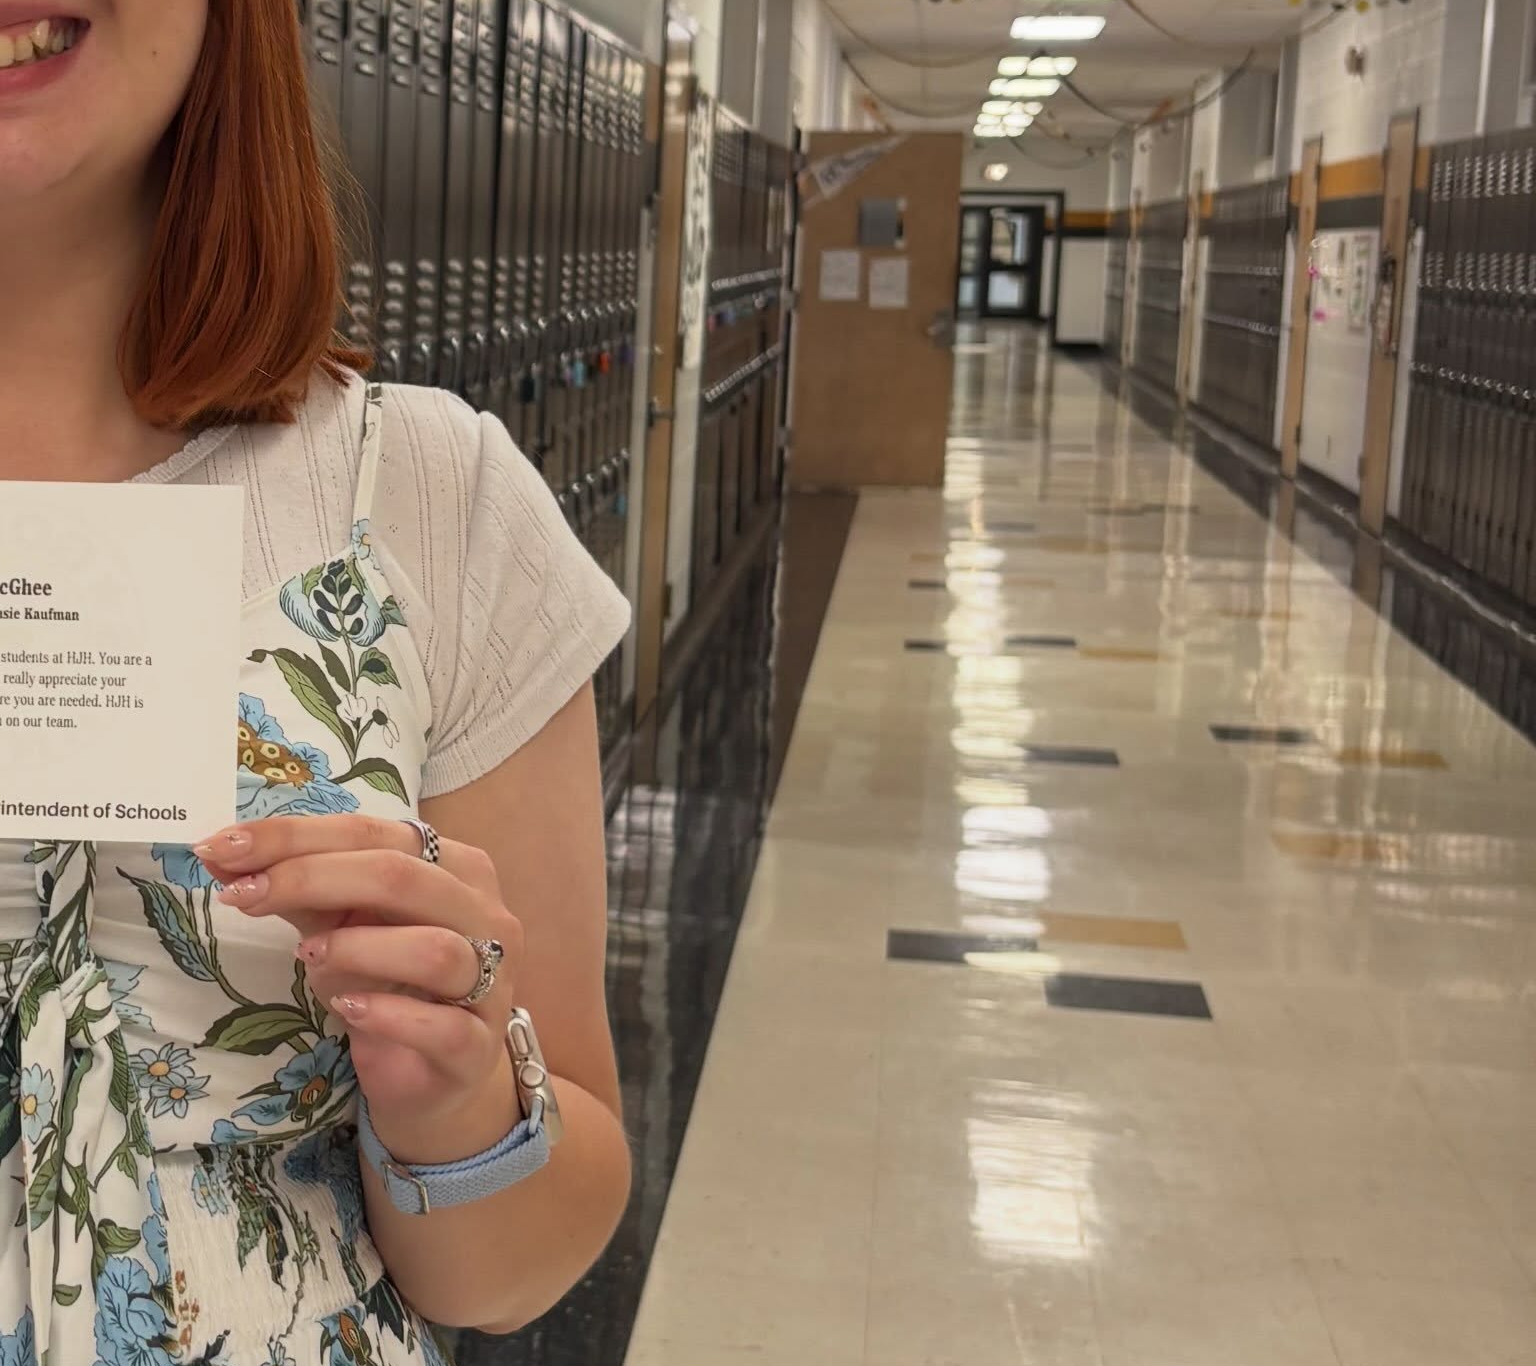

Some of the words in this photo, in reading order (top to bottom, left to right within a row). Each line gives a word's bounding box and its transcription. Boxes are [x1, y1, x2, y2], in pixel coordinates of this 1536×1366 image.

[25, 608, 79, 621] Kaufman
[1, 650, 49, 663] students
[52, 653, 63, 664] at
[67, 651, 95, 664] HJH.
[99, 652, 120, 665] You
[124, 656, 142, 665] are
[145, 656, 152, 665] a
[4, 671, 35, 688] really
[39, 673, 97, 688] appreciate
[100, 677, 126, 690] your
[14, 696, 34, 709] you
[38, 697, 56, 706] are
[59, 694, 102, 707] needed.
[106, 695, 130, 708] HJH
[135, 696, 143, 708] is
[6, 717, 19, 726] on
[23, 718, 42, 727] our
[47, 716, 77, 728] team.
[93, 803, 111, 818] of
[115, 804, 186, 820] Schools
